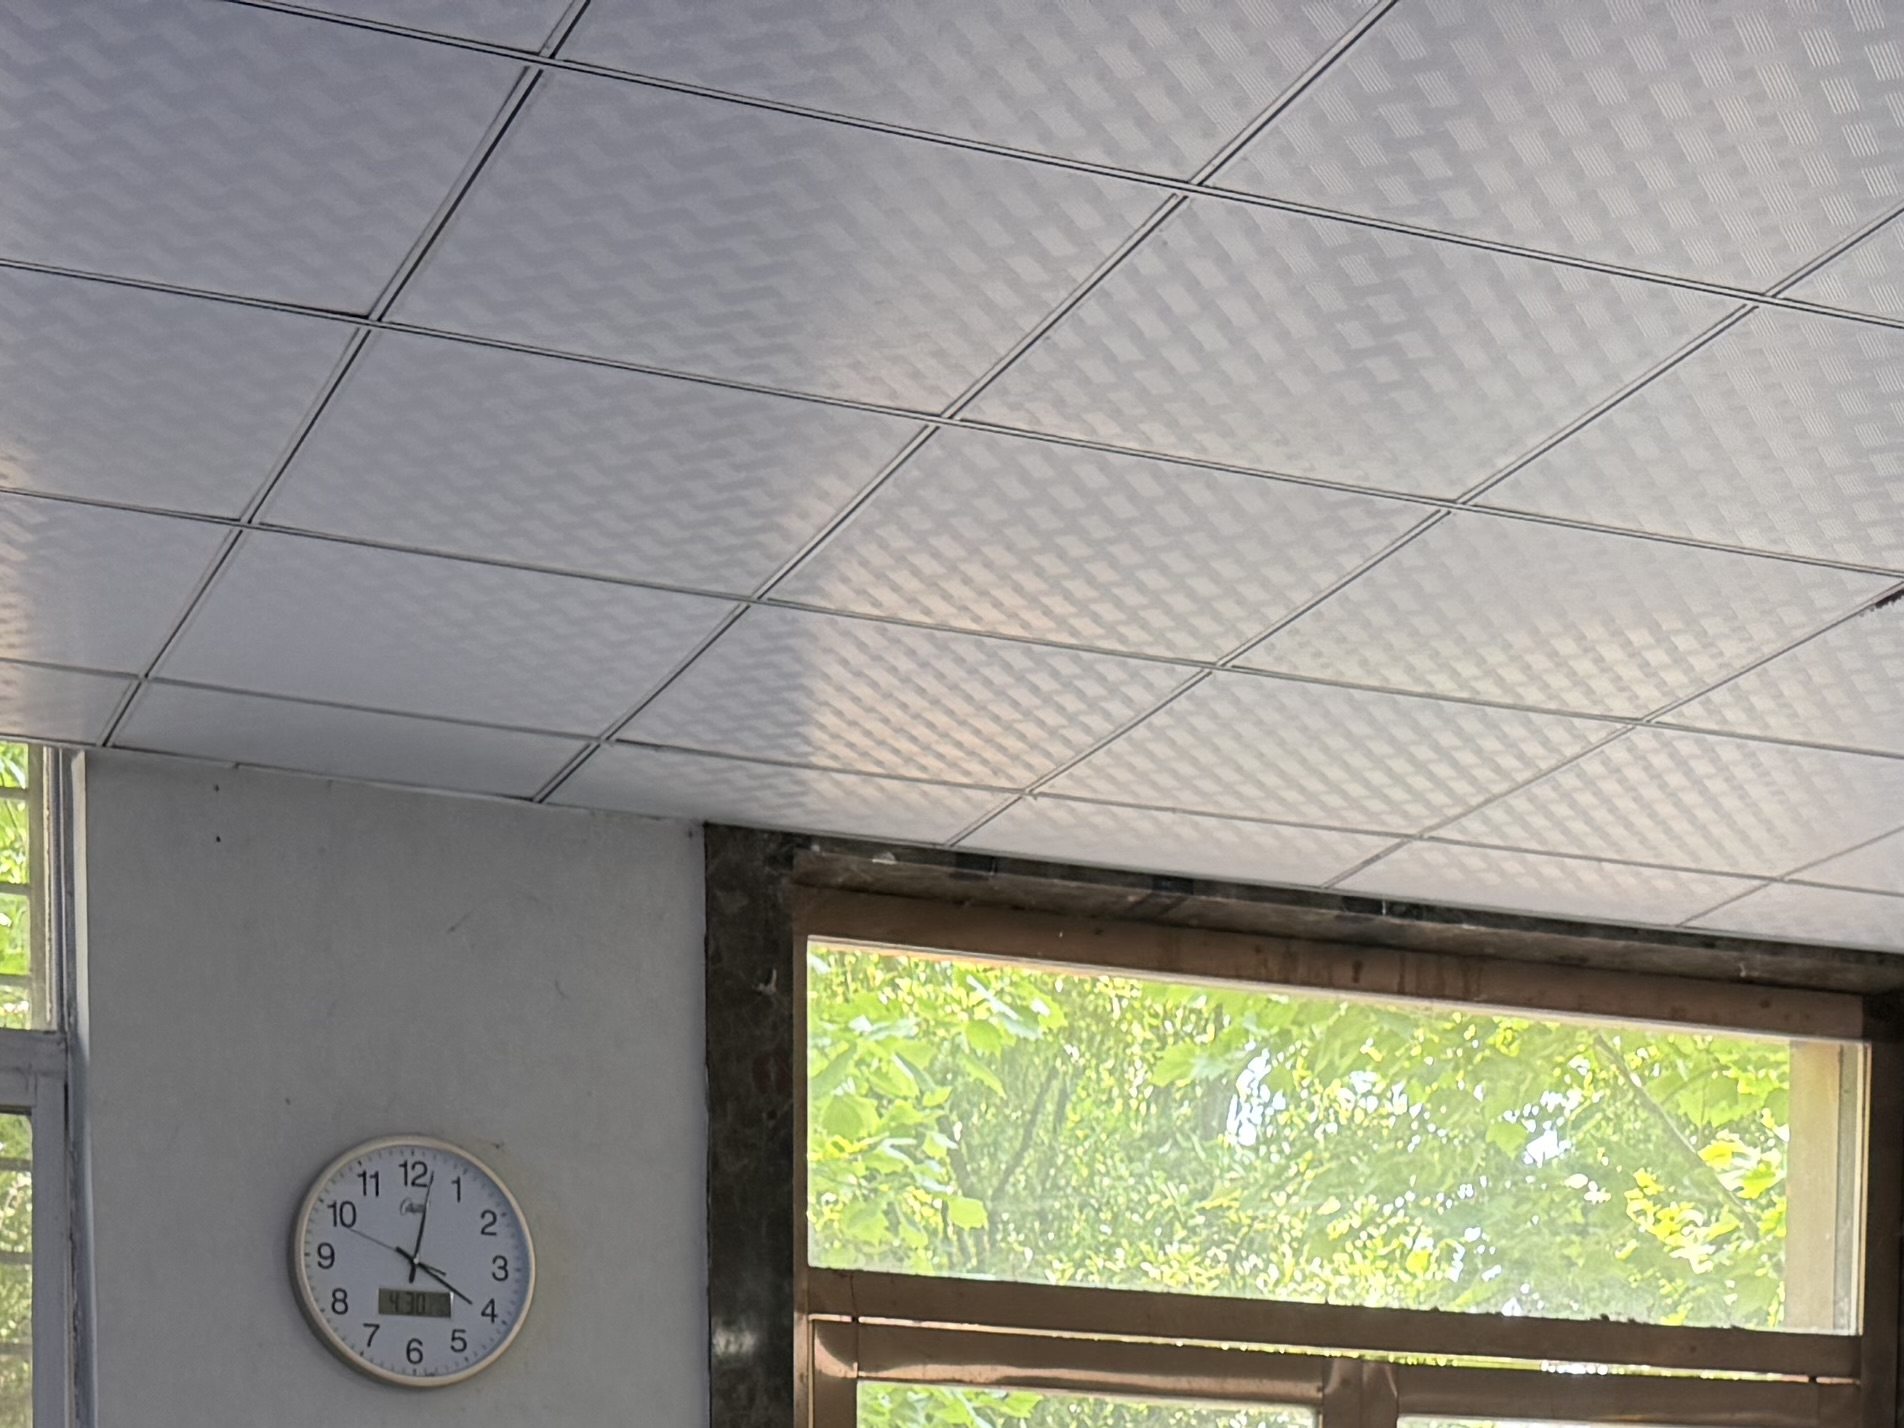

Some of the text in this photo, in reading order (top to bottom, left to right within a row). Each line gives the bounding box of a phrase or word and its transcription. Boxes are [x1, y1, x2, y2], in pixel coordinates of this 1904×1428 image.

[357, 1170, 380, 1197] 11
[399, 1161, 428, 1188] 12
[451, 1177, 462, 1202] 1
[327, 1200, 356, 1228] 10
[480, 1211, 497, 1236] 2
[317, 1242, 335, 1269] 9
[492, 1255, 509, 1281] 3
[331, 1289, 348, 1314] 8
[481, 1298, 498, 1323] 4
[363, 1323, 380, 1347] 7
[450, 1329, 467, 1353] 5
[406, 1339, 423, 1364] 6
